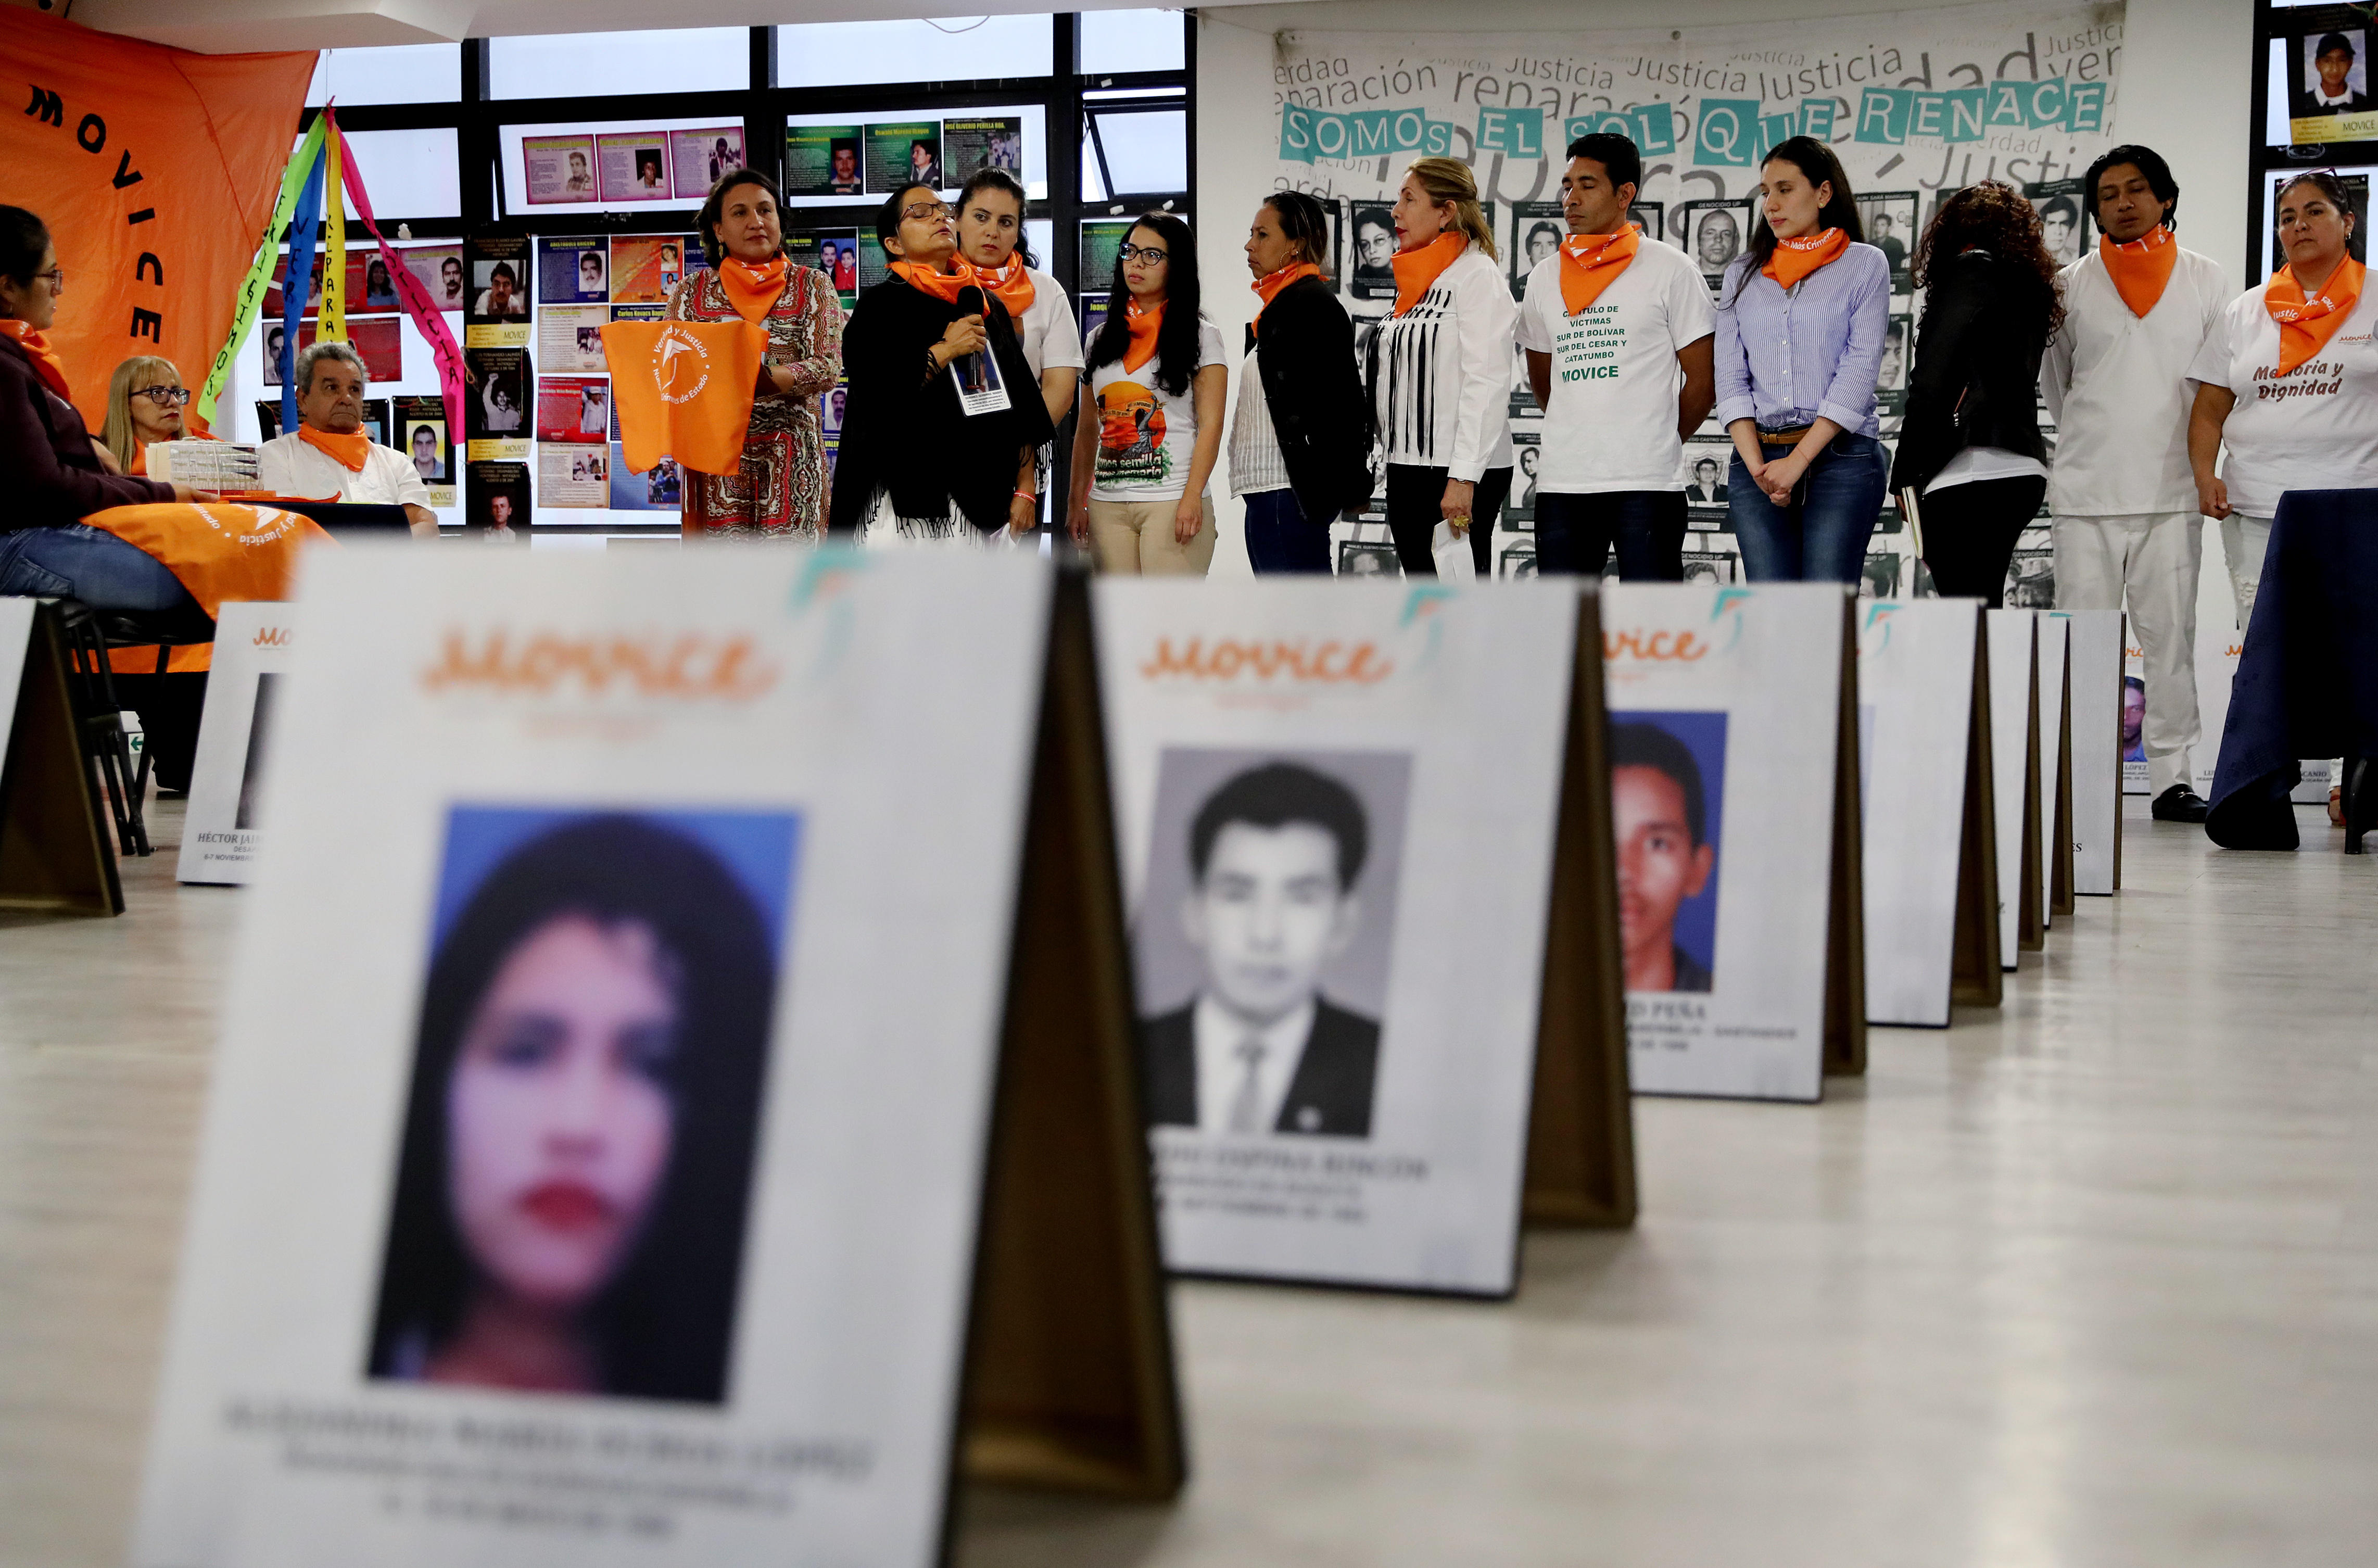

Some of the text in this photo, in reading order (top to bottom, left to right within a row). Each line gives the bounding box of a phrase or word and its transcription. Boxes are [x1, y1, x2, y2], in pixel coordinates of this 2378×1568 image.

[1505, 57, 1613, 89] Justicia
[1627, 57, 1747, 92] Justicia
[1759, 44, 1902, 102] Justicia
[1287, 111, 1447, 154] SOMOS
[1483, 112, 1536, 153] EL
[1701, 105, 1831, 162] QUE
[1863, 84, 2100, 142] RENACE
[2343, 119, 2374, 131] MOVICE
[24, 84, 163, 344] MOVICE
[1790, 237, 1808, 250] Más
[1806, 227, 1837, 250] Crímenes
[325, 212, 334, 342] REPARA
[1563, 306, 1604, 318] CTULO
[1570, 317, 1611, 327] VÍCTIMAS
[503, 331, 526, 339] MOVICE
[653, 325, 673, 353] Verd
[680, 330, 708, 359] Justicia
[1557, 333, 1571, 342] SUR
[1587, 327, 1625, 336] BOLÍVAR
[1557, 345, 1570, 354] SUR
[1571, 342, 1586, 350] DEL
[1589, 340, 1618, 348] CESAR
[1565, 351, 1614, 363] CATATUMBO
[1562, 365, 1619, 383] MOVICE
[2332, 362, 2344, 378] y
[680, 395, 689, 403] de
[688, 374, 708, 398] Estado
[2258, 378, 2343, 402] Dignidad
[1120, 452, 1161, 467] semilla
[1117, 466, 1161, 476] memoria
[430, 491, 452, 500] MOVICE
[239, 528, 282, 546] Justicia
[197, 831, 238, 843] HÉCTOR
